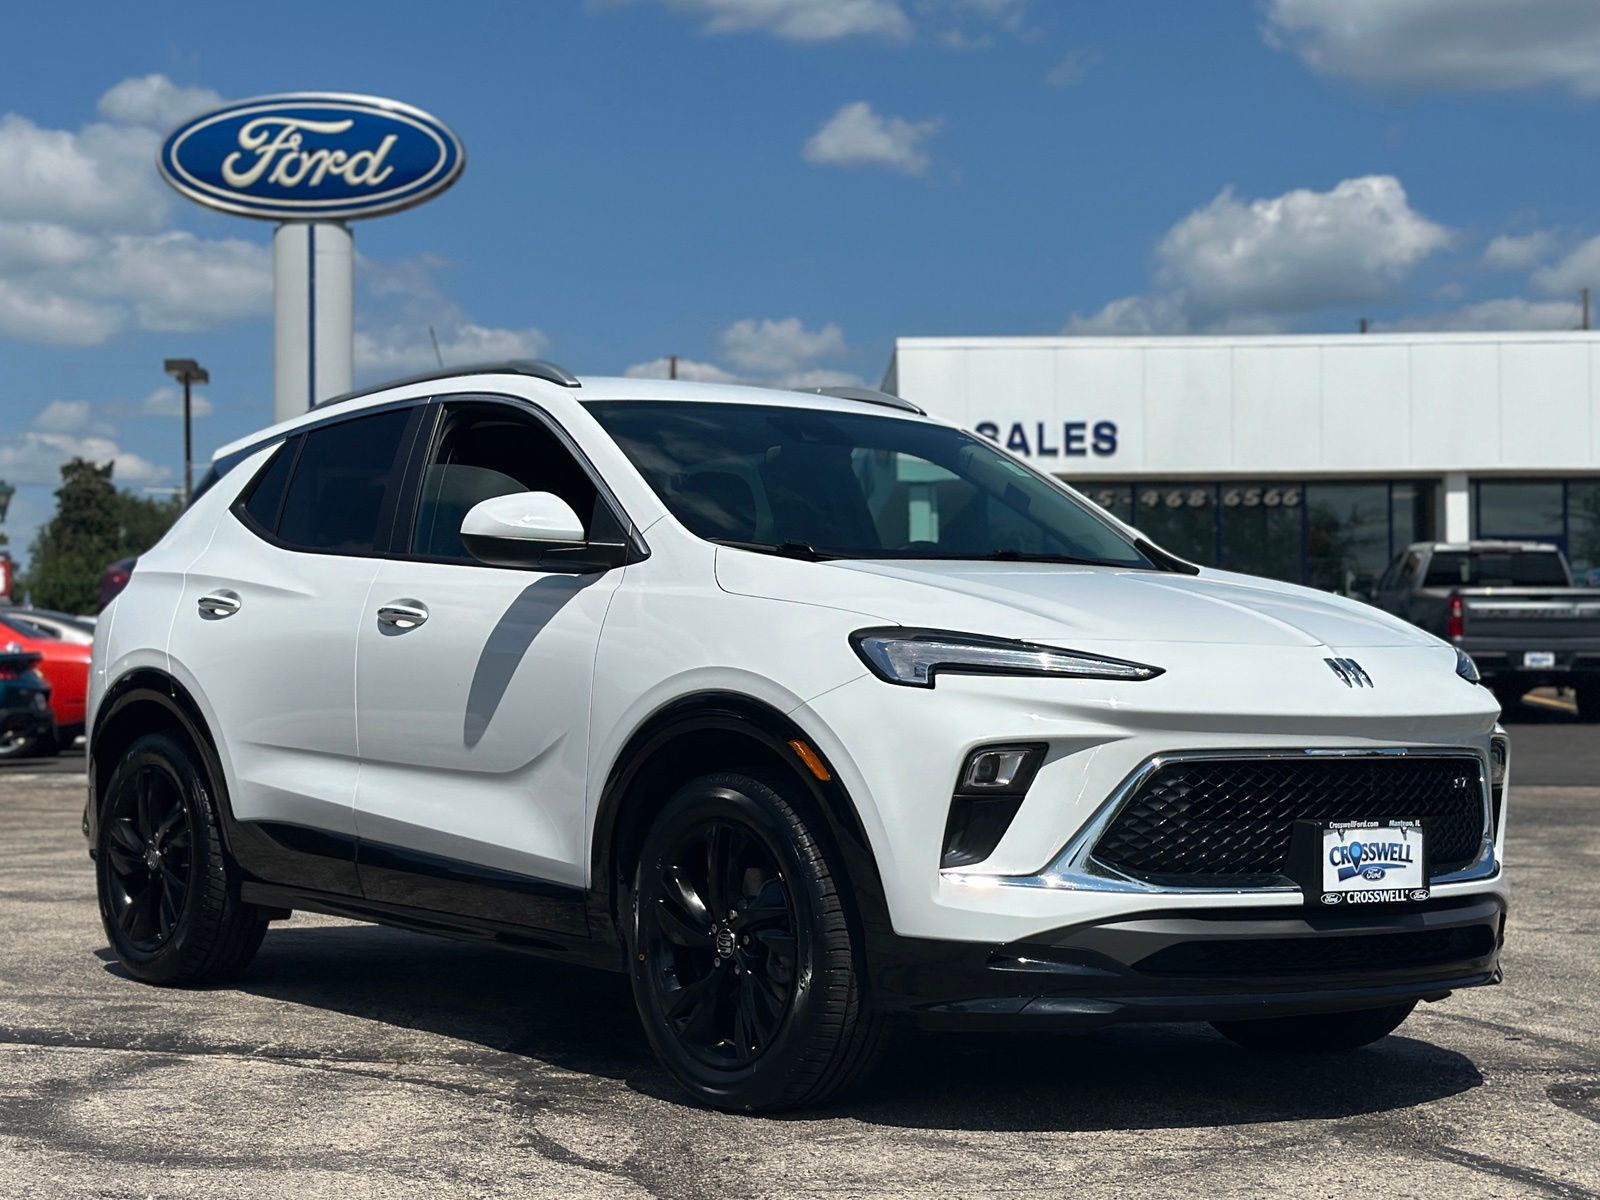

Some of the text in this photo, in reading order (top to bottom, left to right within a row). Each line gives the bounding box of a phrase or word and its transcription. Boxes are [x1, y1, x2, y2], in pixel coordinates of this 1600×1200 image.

[221, 116, 398, 188] Ford
[974, 421, 1118, 457] SALES
[1329, 820, 1379, 829] CrosswellFord.com
[1329, 841, 1413, 867] CROSSWELL
[1366, 868, 1382, 879] Ford
[1347, 889, 1407, 904] CROSSWELL
